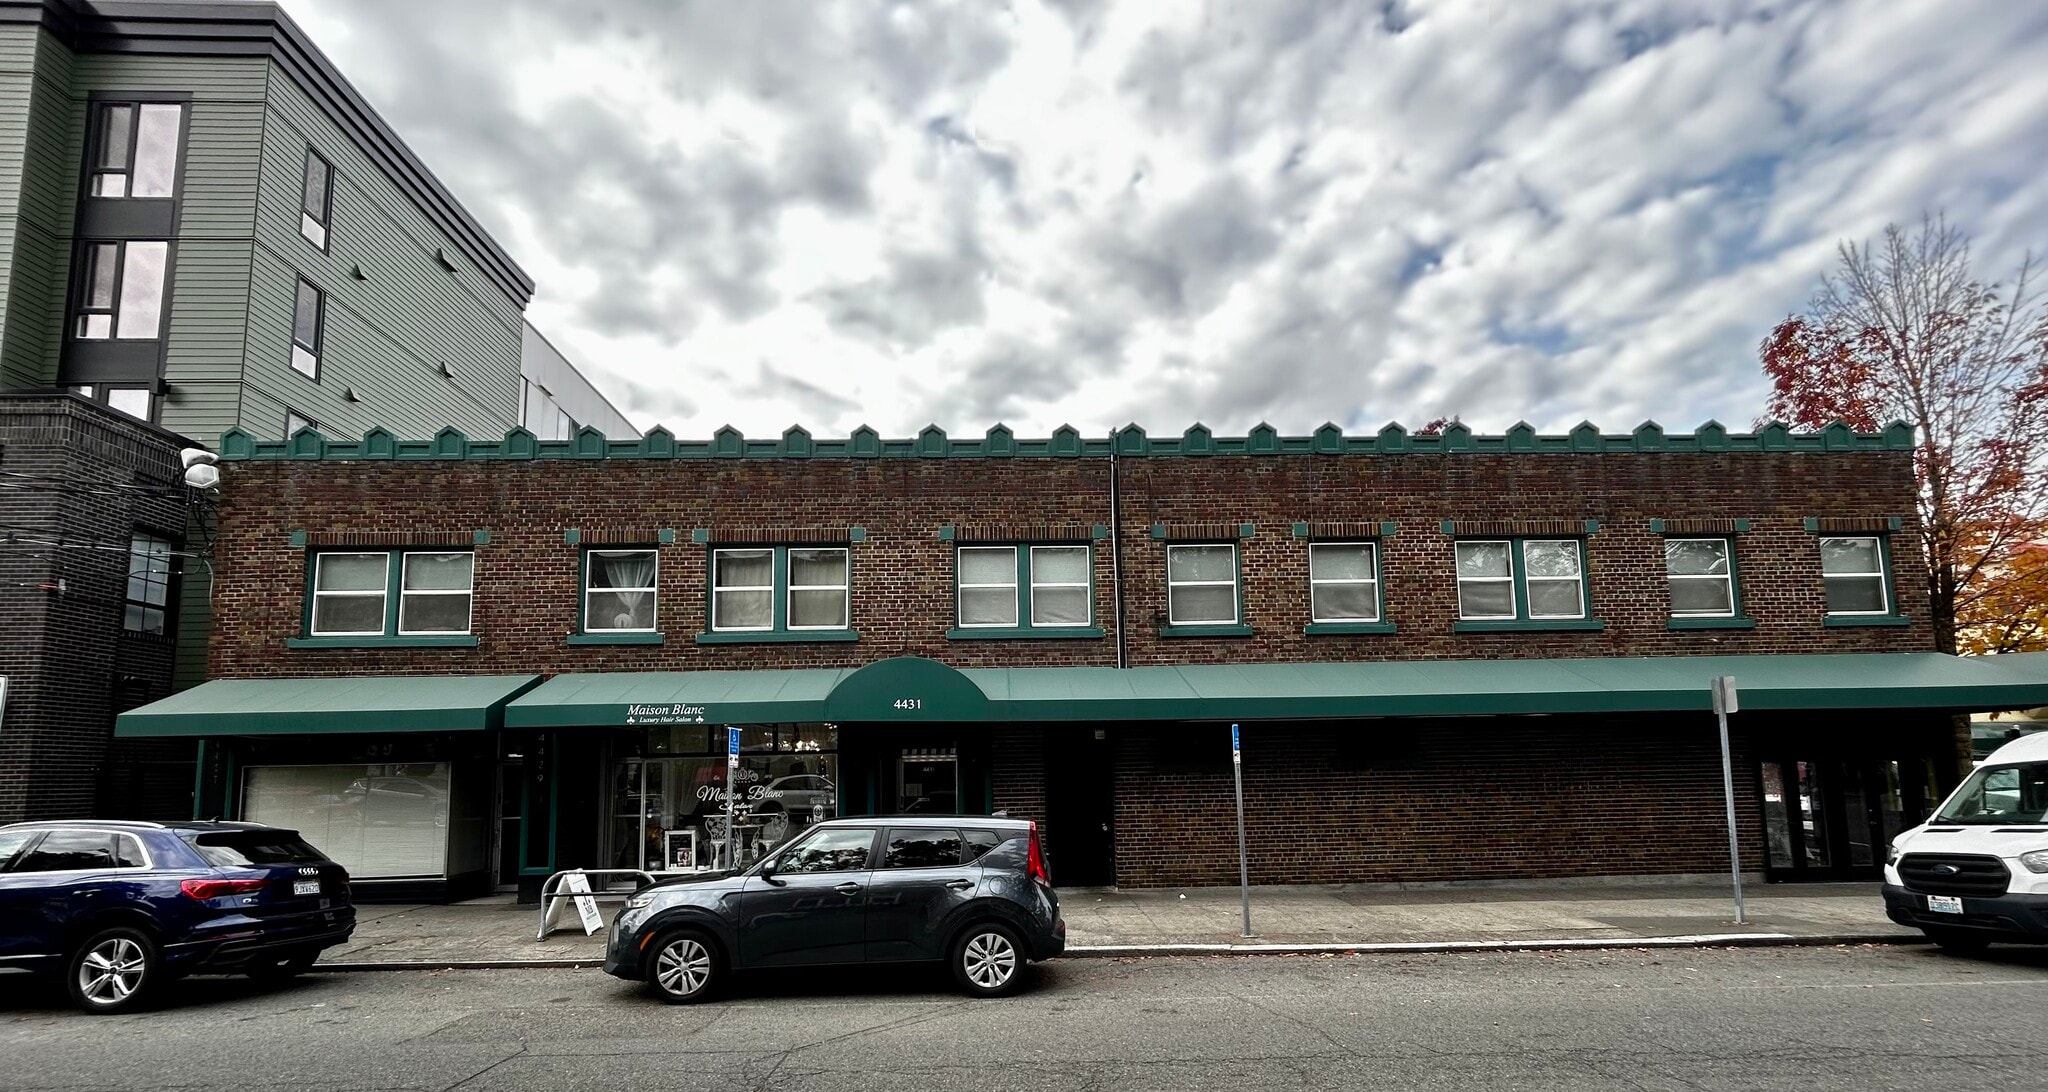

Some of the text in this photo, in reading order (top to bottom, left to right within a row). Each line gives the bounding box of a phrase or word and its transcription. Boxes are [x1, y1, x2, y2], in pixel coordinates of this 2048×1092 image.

[627, 703, 705, 715] Maison Blanc
[893, 699, 921, 710] 4431
[639, 716, 660, 724] Luxury
[696, 785, 784, 802] Maion Blanc
